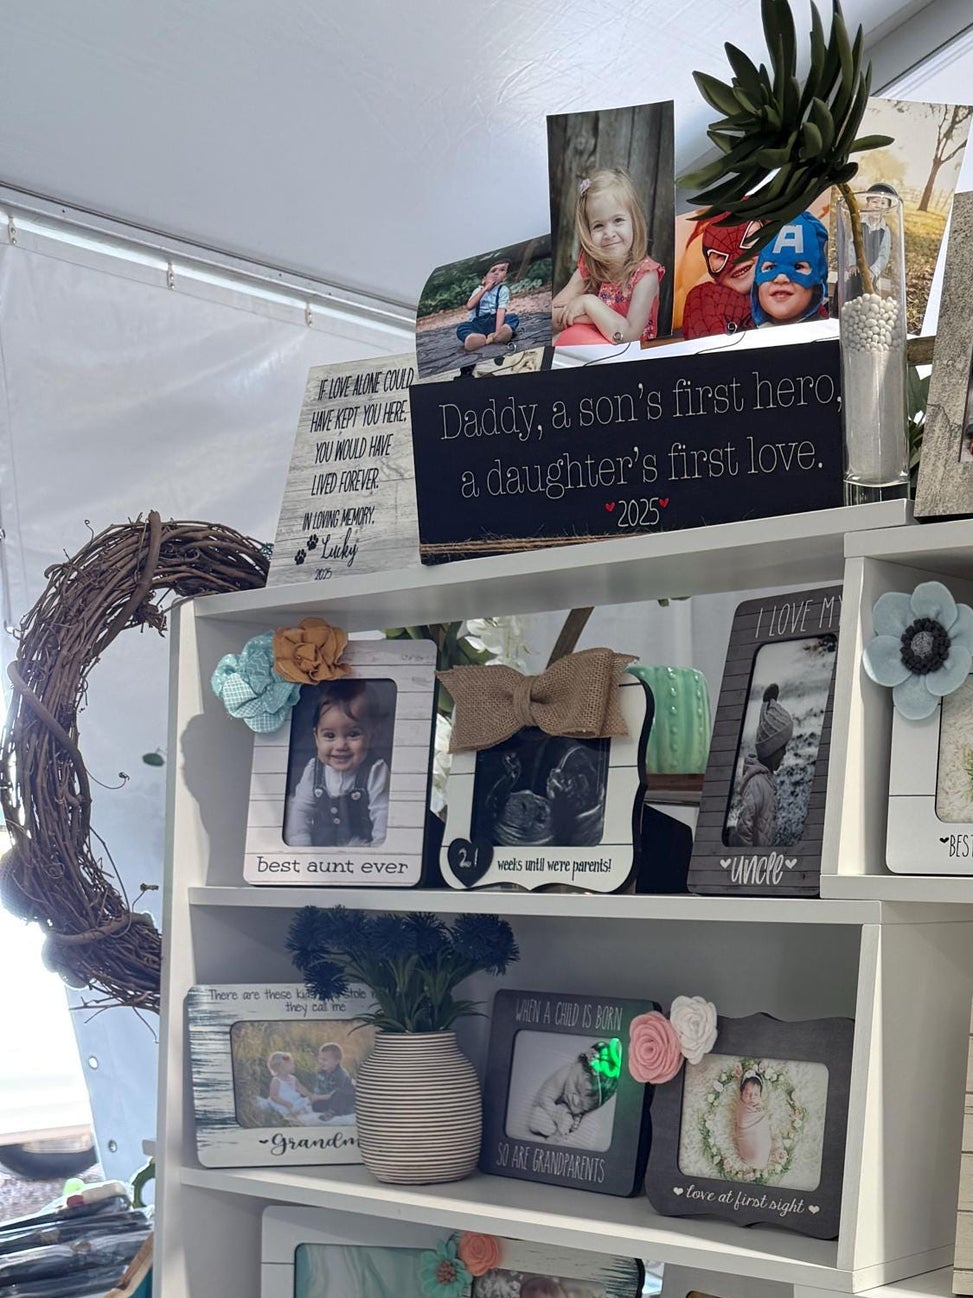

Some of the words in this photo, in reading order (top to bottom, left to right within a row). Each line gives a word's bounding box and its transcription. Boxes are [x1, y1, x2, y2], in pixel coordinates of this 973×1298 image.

[328, 376, 352, 399] LOVE
[352, 372, 381, 396] ALONE
[383, 367, 414, 392] COULD
[310, 409, 334, 433] HAVE
[334, 406, 360, 430] KEPT
[363, 403, 381, 426] YOU
[440, 396, 543, 442] Daddy,
[552, 400, 571, 428] a
[579, 382, 663, 426] son's
[672, 378, 744, 418] first
[752, 372, 843, 413] hero,
[315, 442, 334, 464] YOU
[334, 437, 366, 461] WOULD
[368, 434, 394, 456] HAVE
[311, 472, 337, 496] LIVED
[338, 467, 379, 493] FOREVER.
[461, 470, 480, 498] a
[486, 446, 658, 500] daughter's
[667, 442, 738, 481] first
[746, 436, 824, 474] love.
[312, 509, 340, 530] LOVING
[340, 506, 375, 528] MEMORY.
[617, 497, 660, 528] 2025
[320, 528, 359, 568] Lucky
[755, 608, 763, 638] I
[768, 600, 814, 637] LOVE
[256, 856, 300, 874] best
[306, 860, 354, 874] aunt
[360, 862, 408, 874] ever
[496, 858, 522, 872] weeks
[524, 856, 545, 872] until
[572, 858, 612, 882] parents!
[730, 851, 784, 885] uncle
[208, 989, 238, 1000] There
[242, 991, 260, 1000] are
[264, 988, 293, 1000] these
[285, 1002, 308, 1018] they
[312, 1002, 328, 1012] call
[332, 1002, 346, 1012] me
[515, 998, 540, 1024] WHEN
[543, 1001, 550, 1024] A
[554, 1002, 579, 1027] CHILD
[582, 1006, 593, 1029] IS
[595, 1007, 623, 1032] BORN
[496, 1142, 510, 1167] SO
[512, 1144, 530, 1170] ARE
[532, 1148, 606, 1184] GRANDPARENTS
[718, 1190, 734, 1204] at
[734, 1191, 768, 1210] first
[768, 1198, 804, 1218] sight
